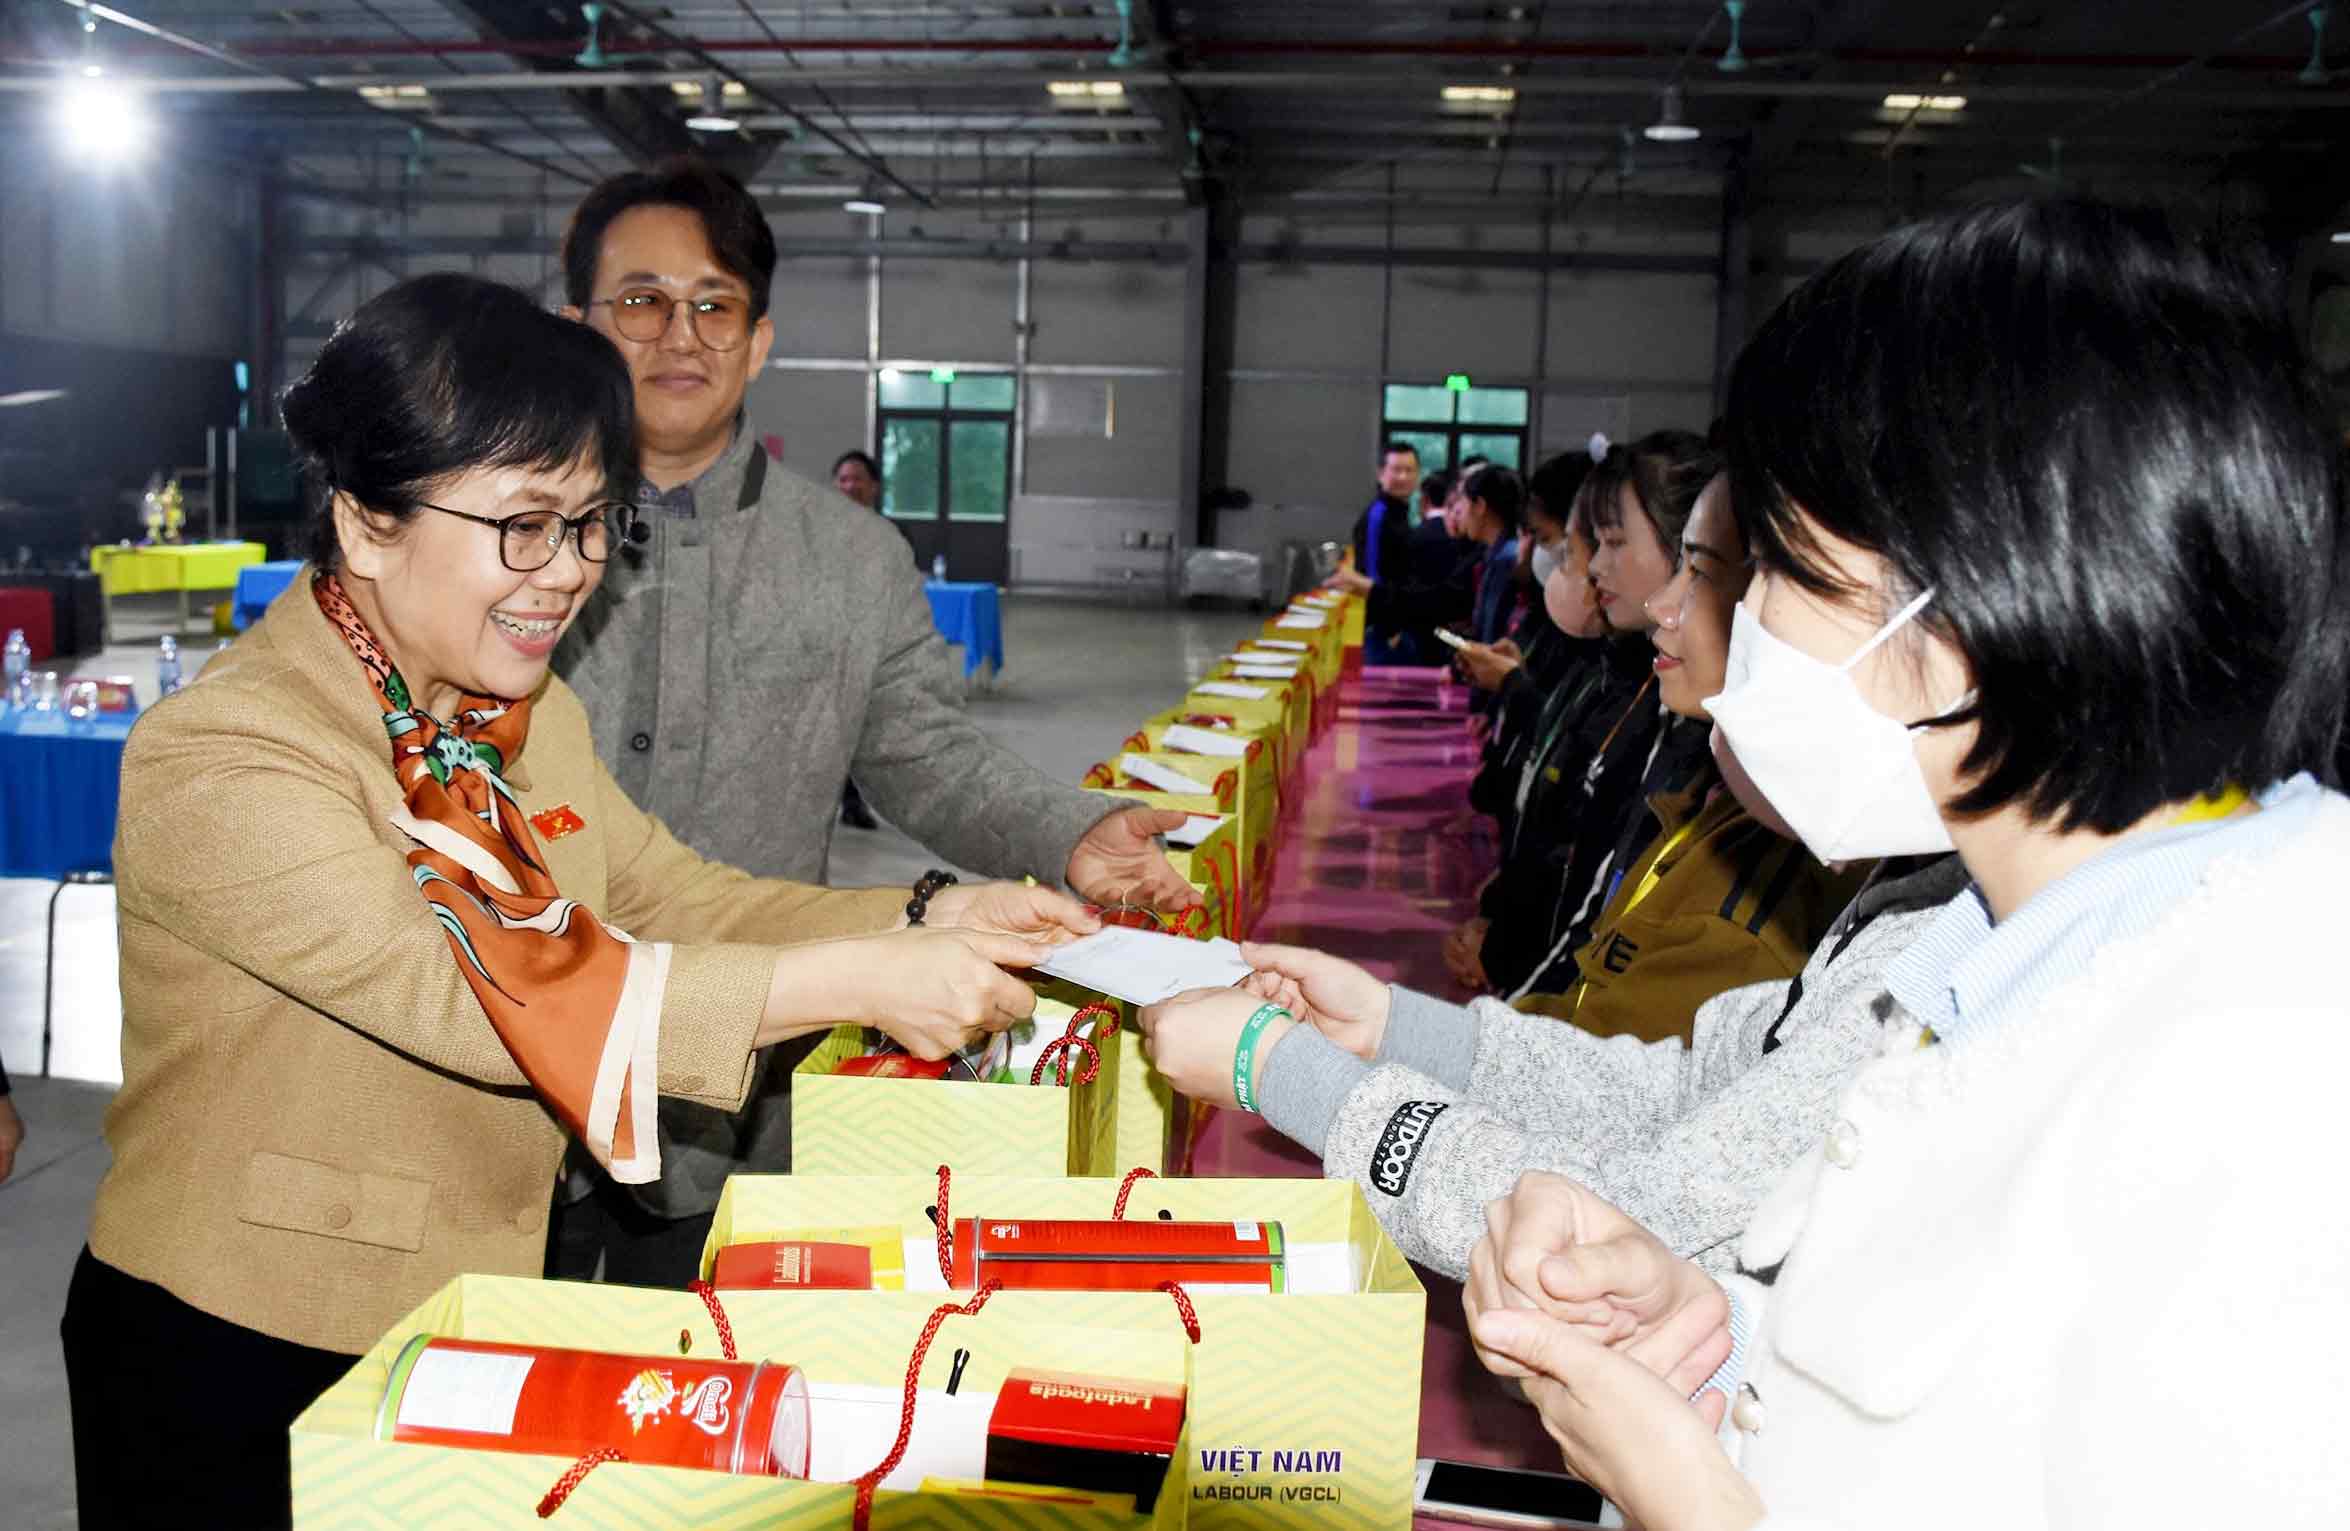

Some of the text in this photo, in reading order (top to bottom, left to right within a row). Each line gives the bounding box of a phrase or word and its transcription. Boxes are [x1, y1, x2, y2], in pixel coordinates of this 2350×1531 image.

[1378, 1101, 1444, 1192] OUTDOOR
[1201, 1445, 1341, 1477] VIỆT NAM
[1193, 1485, 1341, 1504] LABOUR (VGCL)
